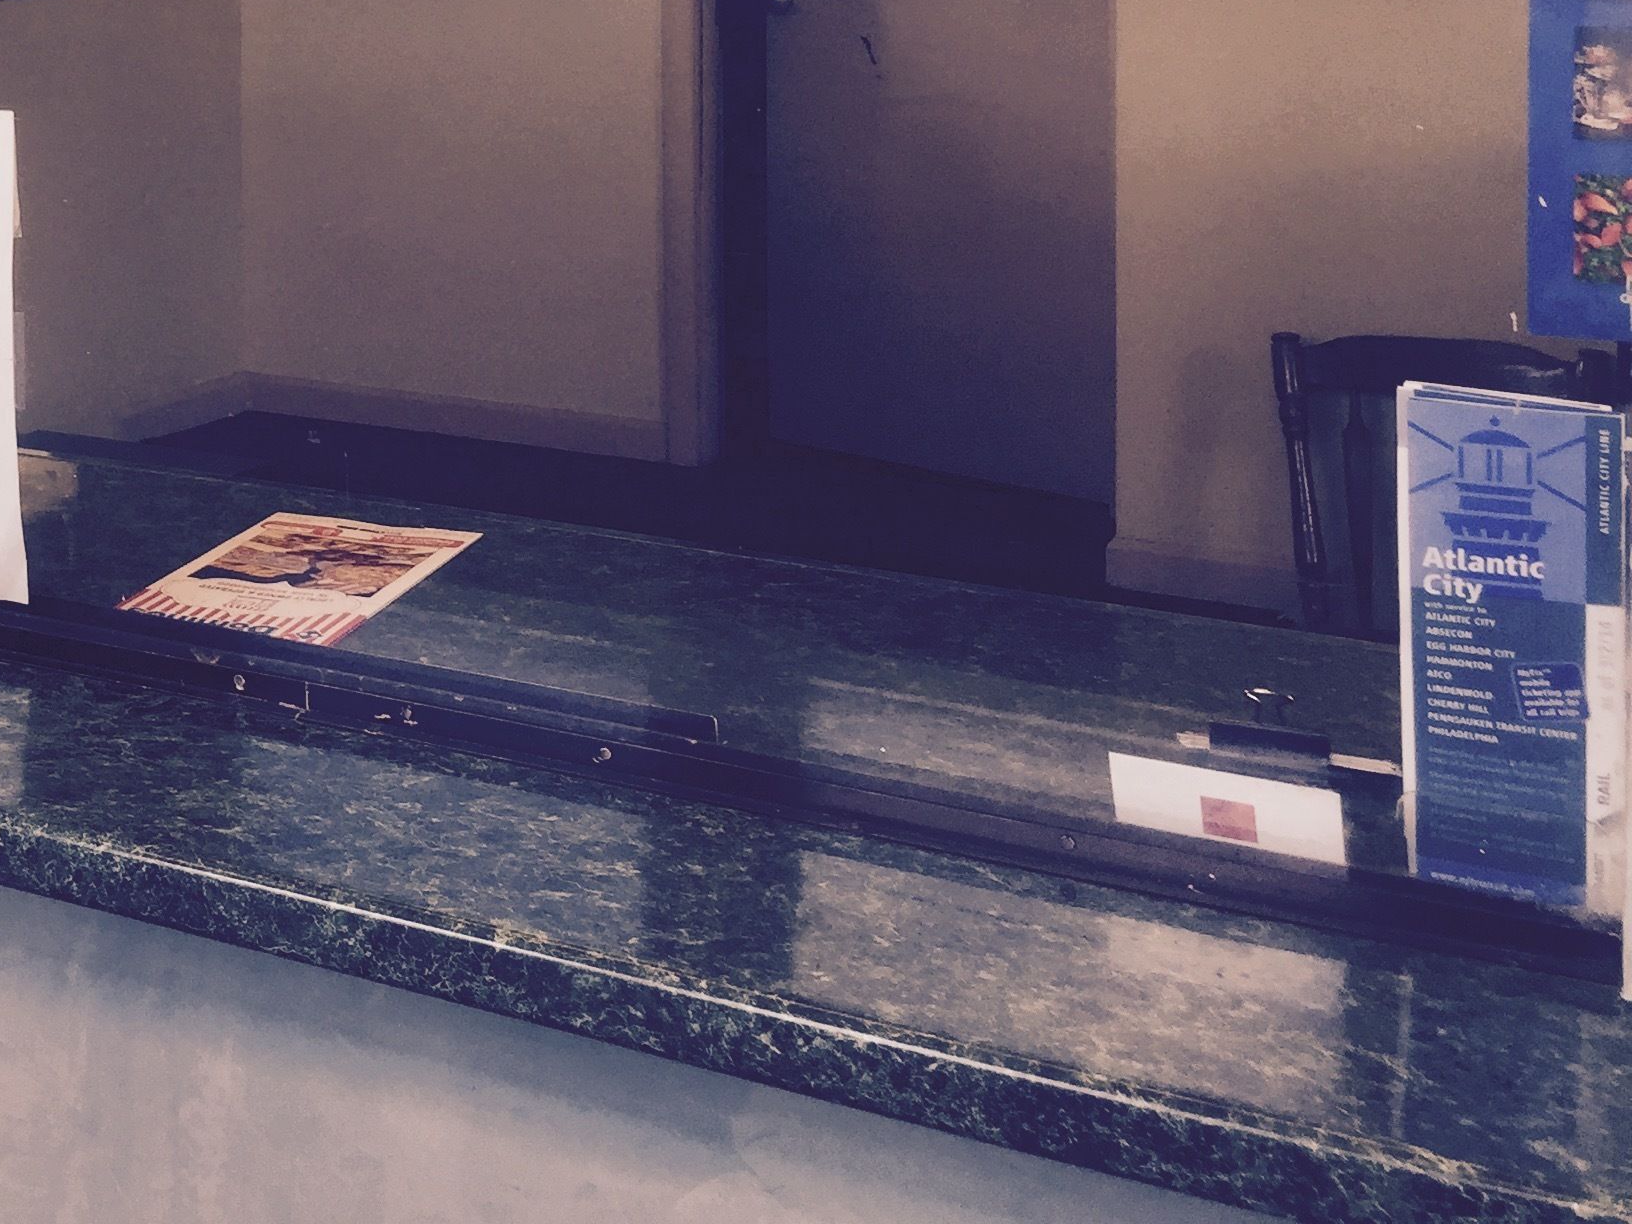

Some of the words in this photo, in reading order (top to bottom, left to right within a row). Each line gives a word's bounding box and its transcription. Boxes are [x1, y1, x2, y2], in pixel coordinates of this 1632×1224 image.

[1598, 429, 1610, 454] LINE
[1598, 457, 1610, 481] CITY
[1598, 484, 1610, 535] ATLANTIC
[1422, 545, 1546, 580] Atlantic
[1422, 573, 1484, 604] City
[1425, 612, 1471, 625] ATLANTIC
[1474, 616, 1496, 627] CITY
[1426, 626, 1473, 640] ABSECON
[1426, 640, 1447, 652] EGG
[1449, 643, 1492, 657] HARBOR
[1494, 648, 1516, 659] CITY
[1426, 655, 1494, 673] HAMMONTON
[1426, 683, 1495, 701] LINDENWOLD
[1427, 697, 1466, 712] CHERRY
[1467, 701, 1490, 715] HILL
[1427, 711, 1494, 730] PENNSAUKEN
[1495, 720, 1537, 736] TRANSIT
[1539, 727, 1578, 741] CENTER
[1428, 725, 1499, 744] PHILADELPHIA
[1597, 772, 1611, 806] RAIL
